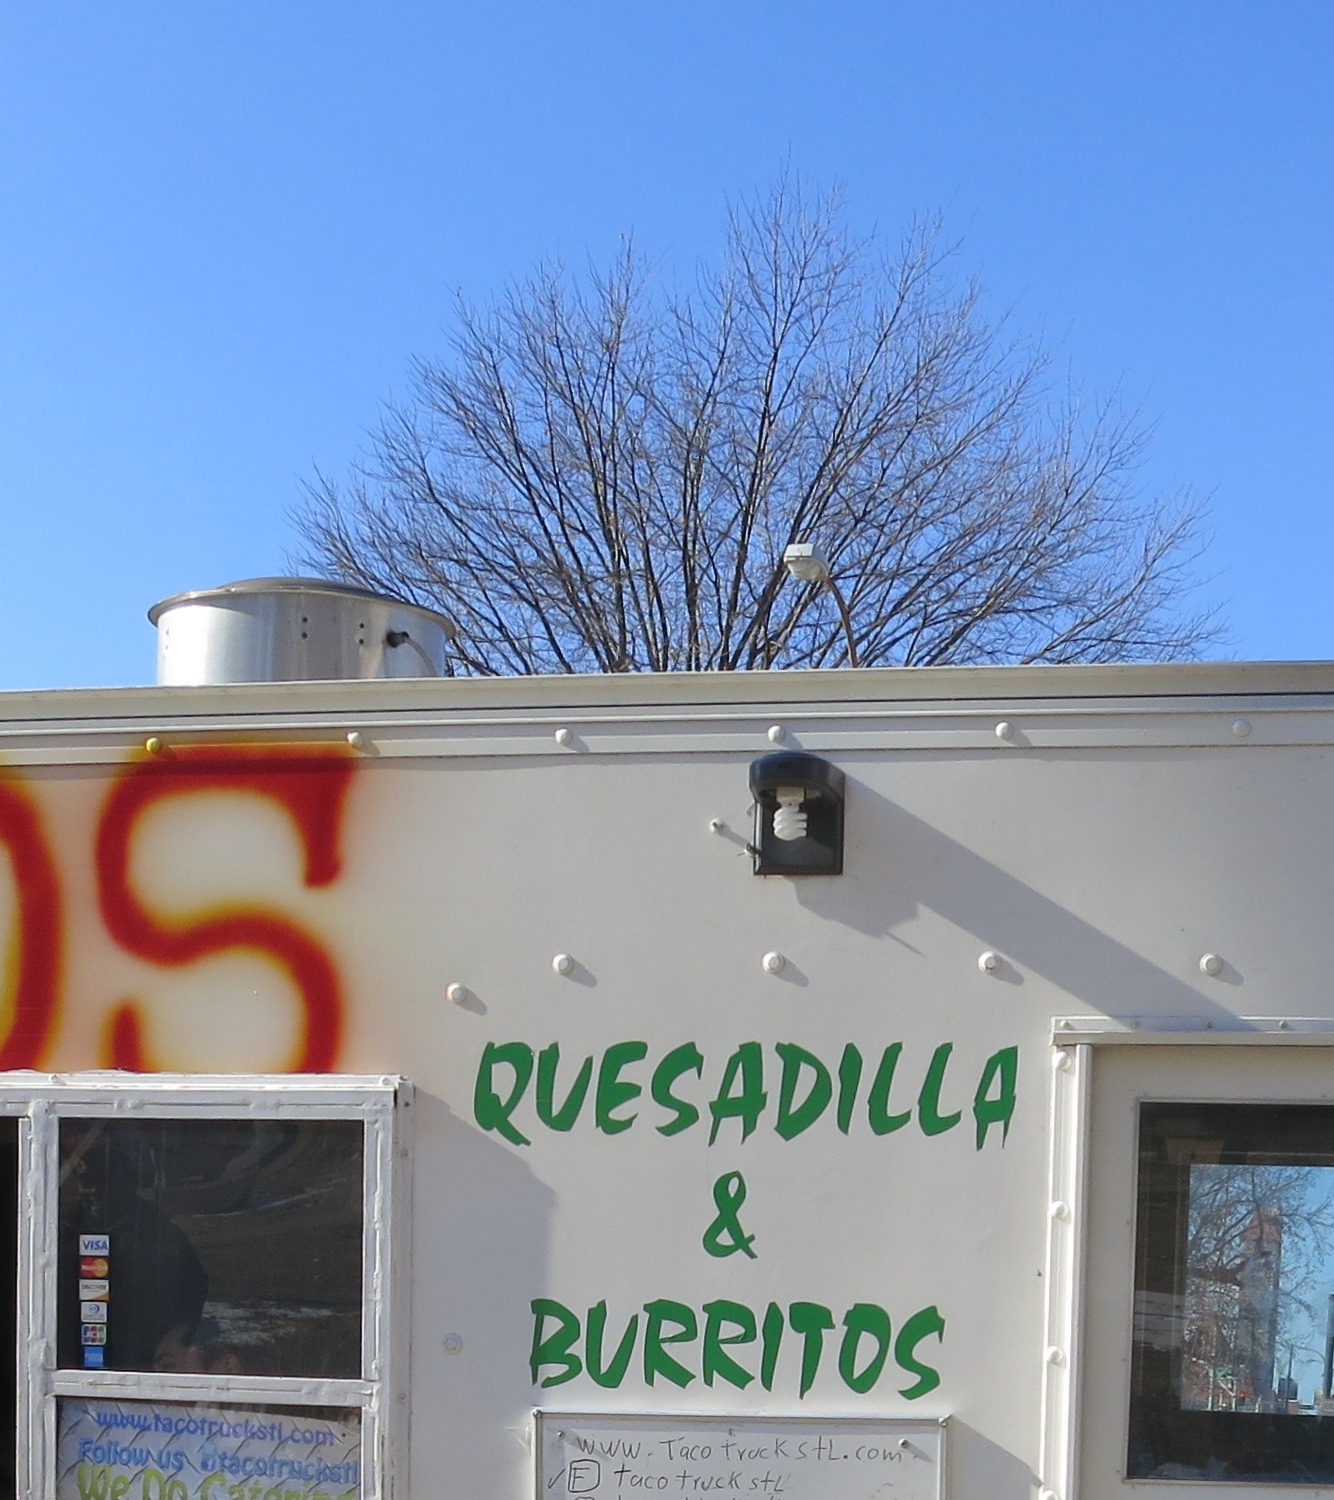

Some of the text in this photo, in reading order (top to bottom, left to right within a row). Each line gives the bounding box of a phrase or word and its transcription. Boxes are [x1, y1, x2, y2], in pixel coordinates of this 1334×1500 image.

[473, 1041, 1019, 1151] QUESADILLA
[82, 1240, 108, 1251] VISA
[702, 1170, 758, 1259] &
[529, 1299, 946, 1400] BURRITOS
[78, 1438, 358, 1484] Follow us tacotruckstl
[97, 1411, 335, 1446] www.tacotruckstl.com
